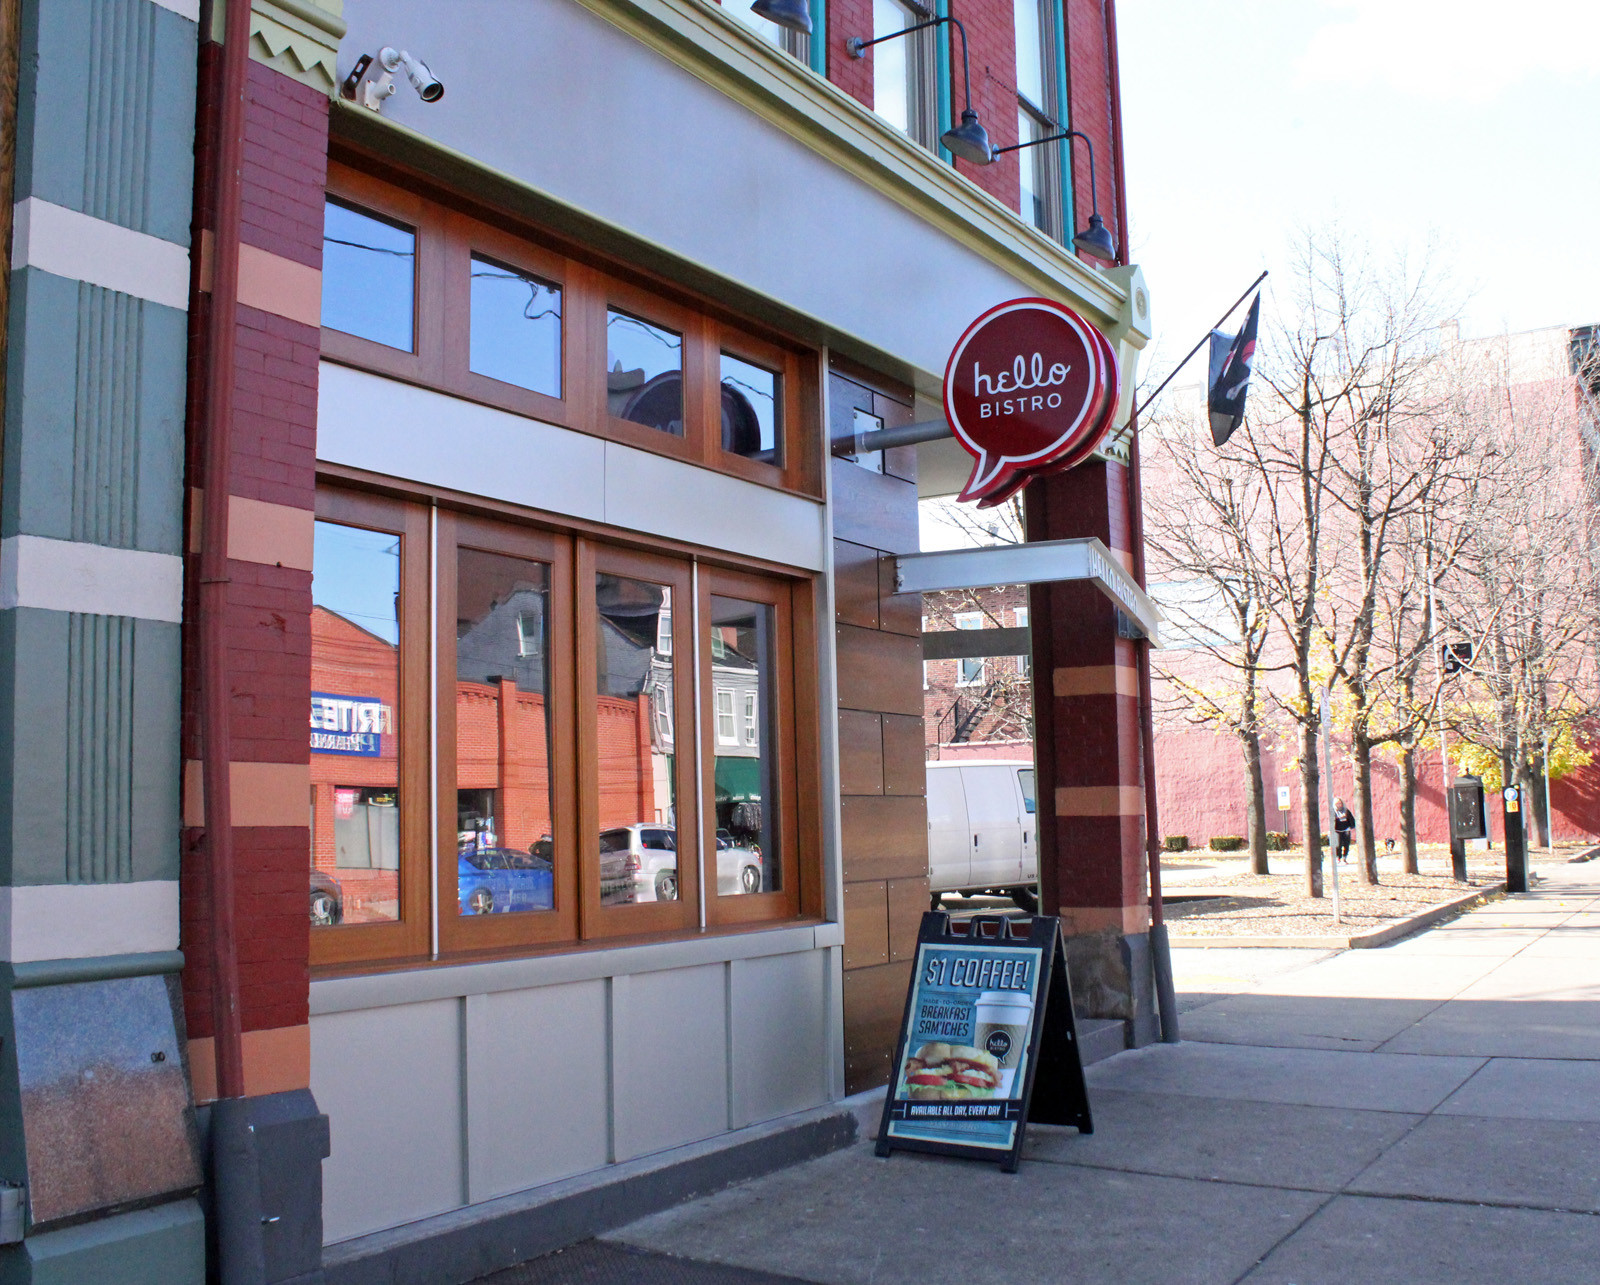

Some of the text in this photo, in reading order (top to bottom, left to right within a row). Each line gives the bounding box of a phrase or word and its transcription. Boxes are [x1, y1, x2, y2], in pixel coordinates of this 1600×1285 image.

[974, 352, 1071, 397] hello
[980, 393, 1062, 418] BISTRO
[926, 957, 1030, 990] $1 COFFEE!
[920, 1005, 971, 1021] BREAKFAST
[918, 1020, 969, 1037] SAM'ICHES
[911, 1105, 1001, 1117] AVAILABLE ALL DAY, EVERY DAY
